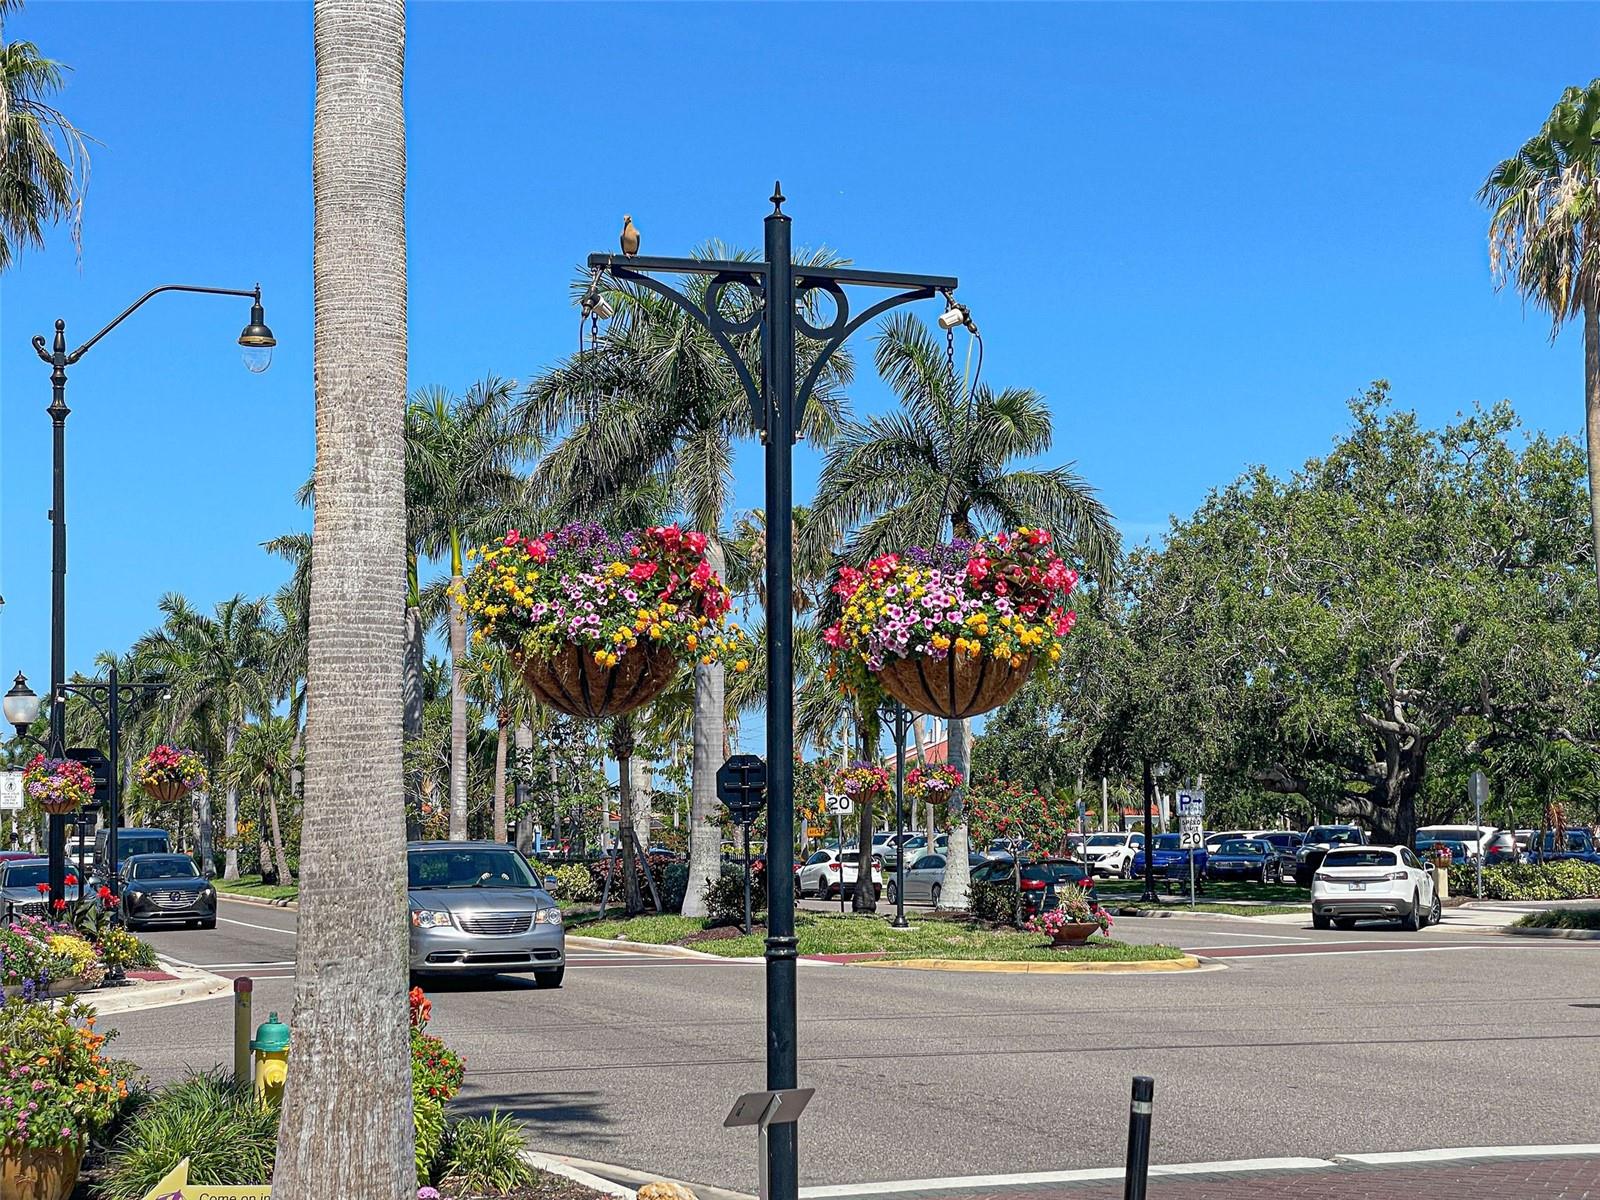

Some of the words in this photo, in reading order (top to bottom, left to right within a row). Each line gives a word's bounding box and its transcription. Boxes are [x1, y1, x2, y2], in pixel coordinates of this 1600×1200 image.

[828, 796, 850, 810] 20
[1180, 795, 1192, 811] P
[1182, 832, 1201, 844] 20
